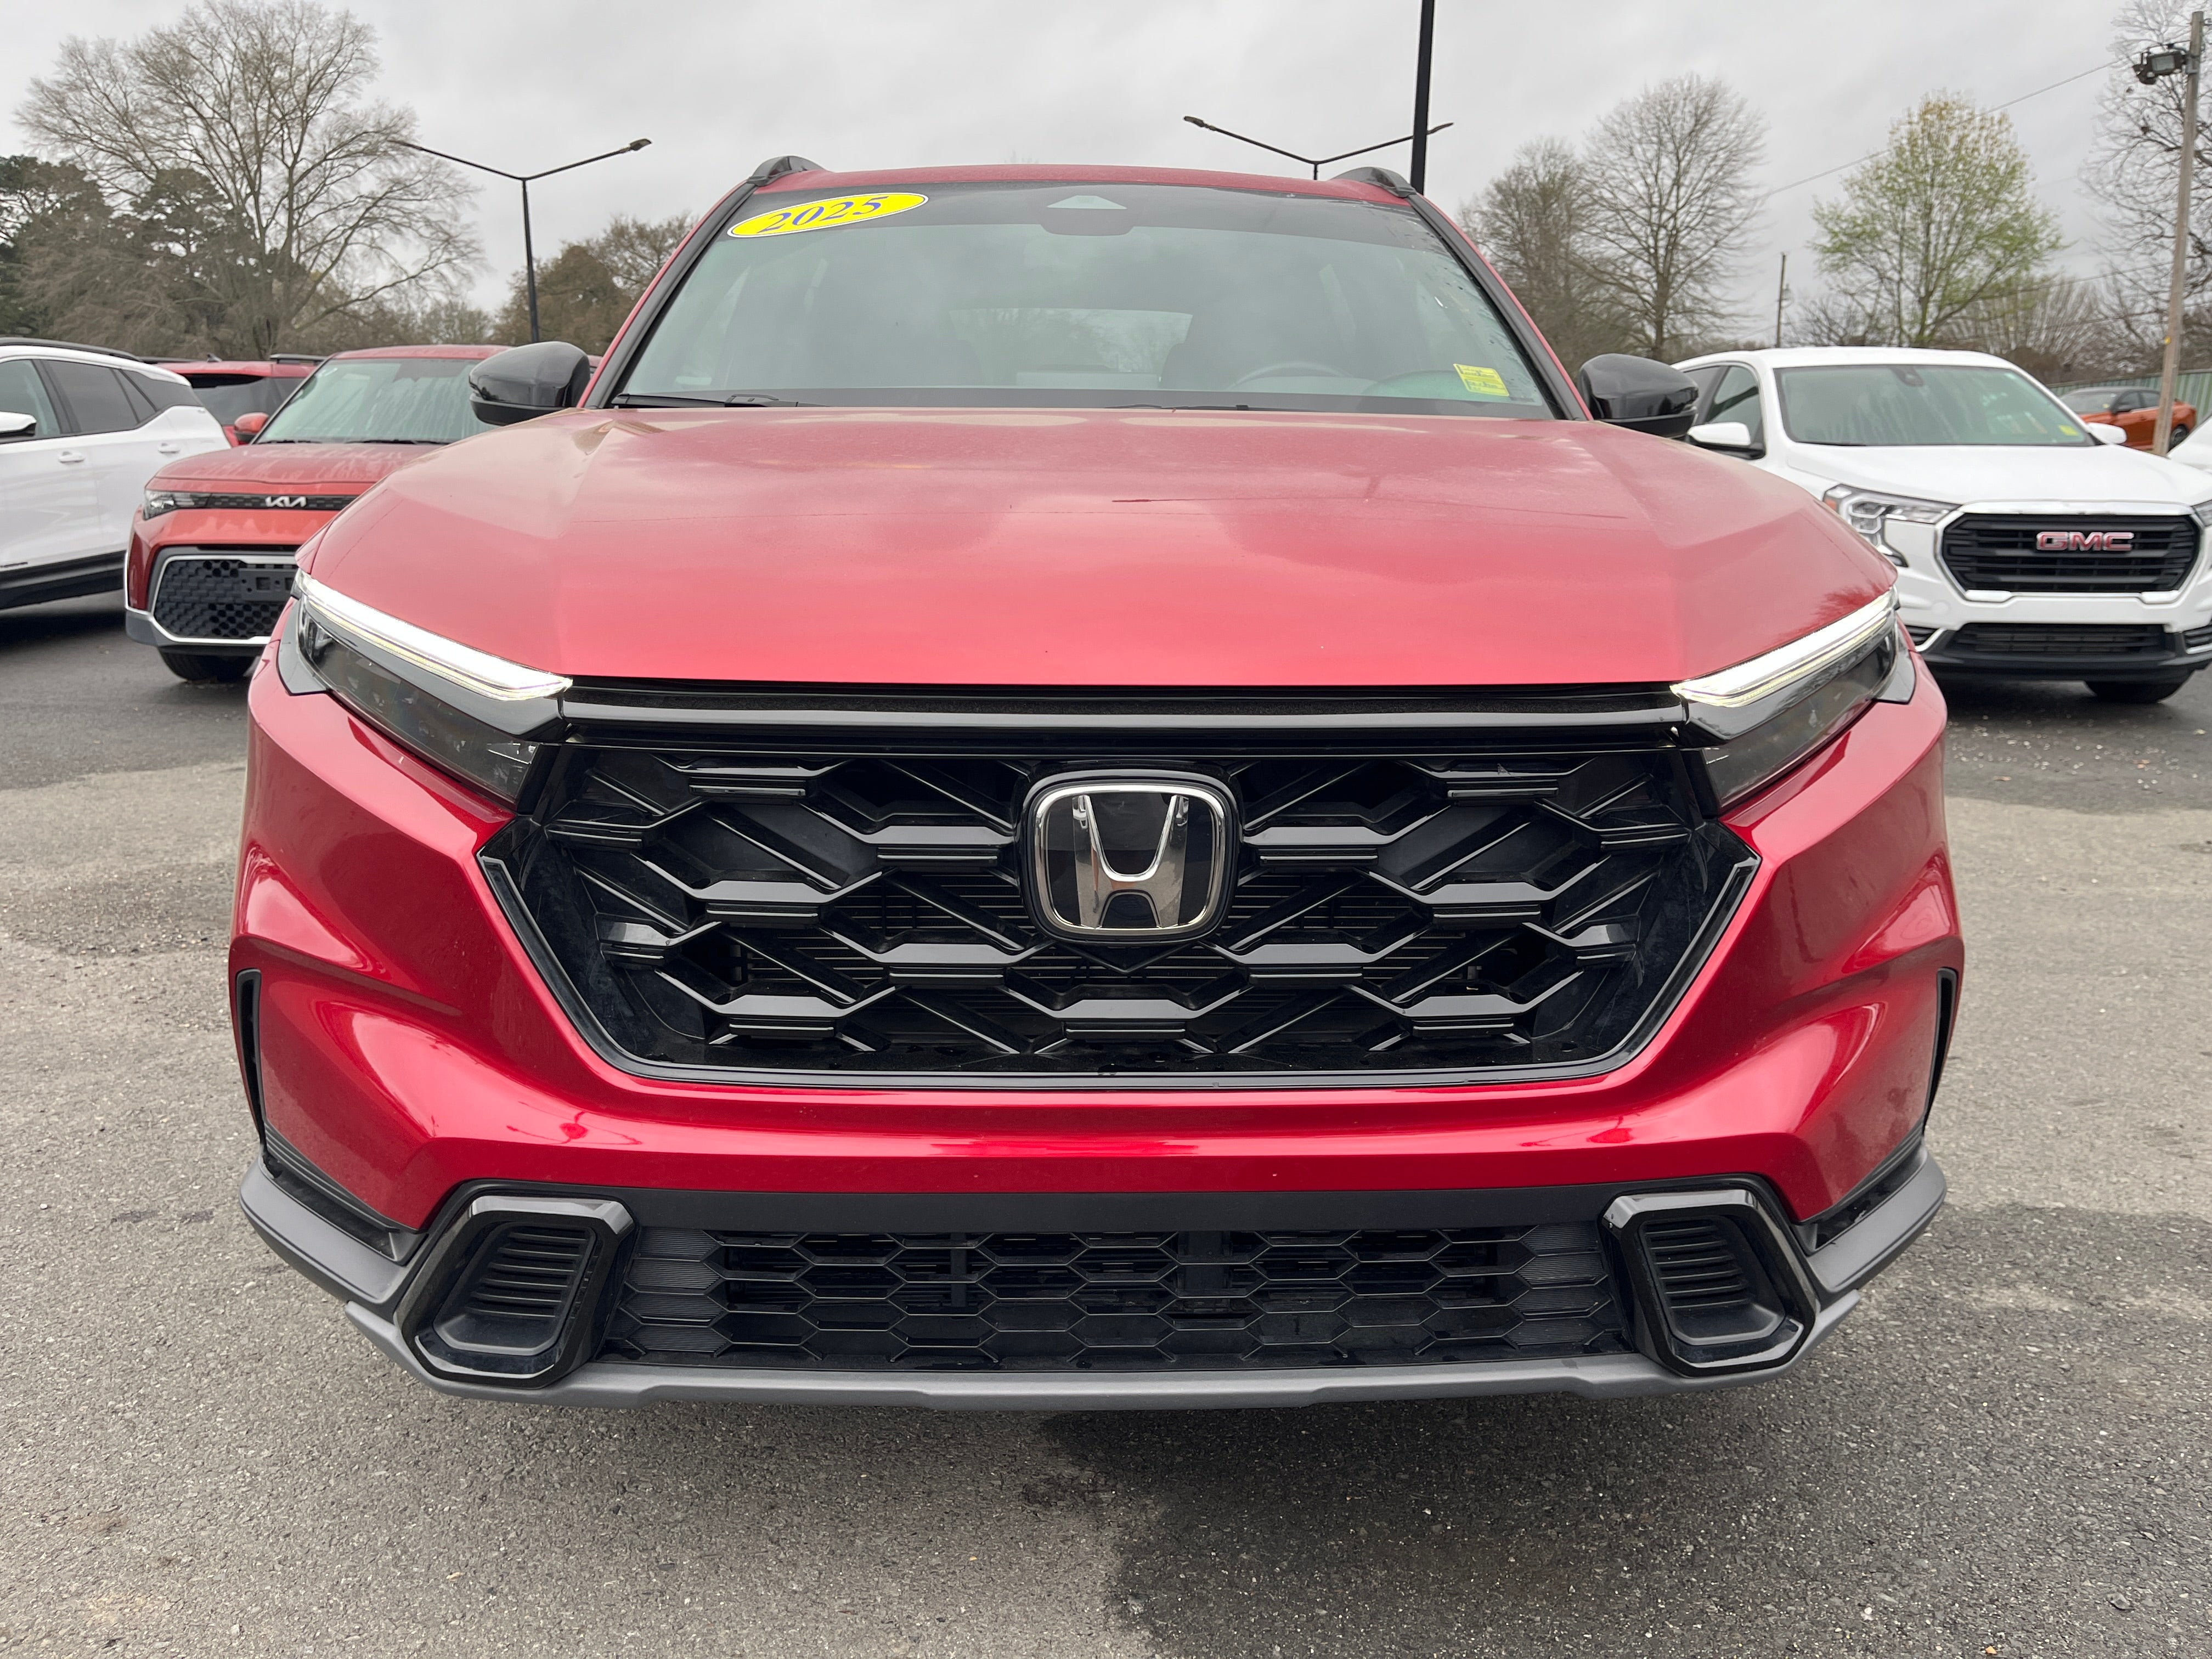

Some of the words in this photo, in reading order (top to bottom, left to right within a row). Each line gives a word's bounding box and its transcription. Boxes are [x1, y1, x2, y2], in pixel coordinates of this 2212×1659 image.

[757, 196, 889, 234] 2025
[265, 496, 307, 507] KIA
[2036, 531, 2134, 551] GMC
